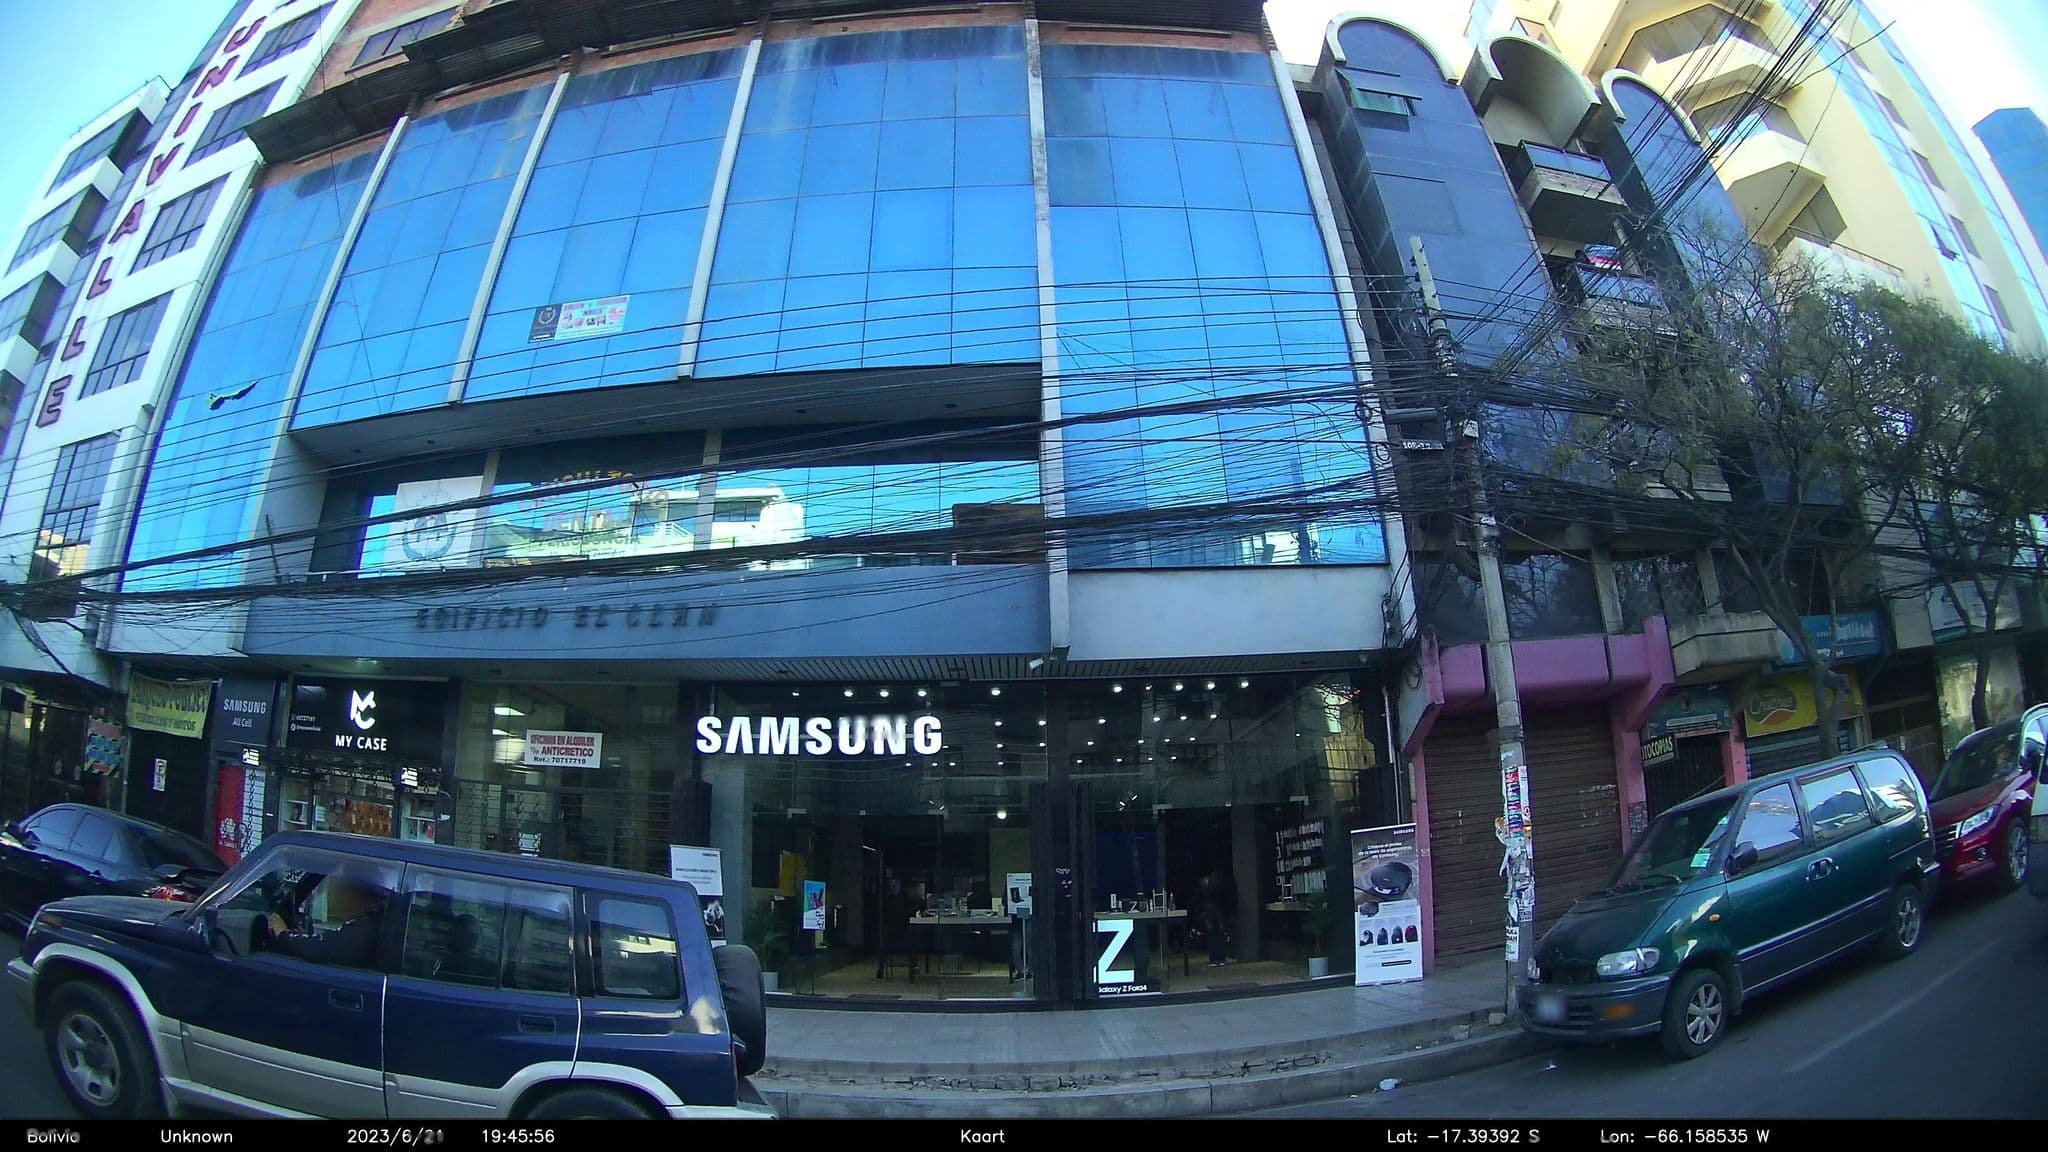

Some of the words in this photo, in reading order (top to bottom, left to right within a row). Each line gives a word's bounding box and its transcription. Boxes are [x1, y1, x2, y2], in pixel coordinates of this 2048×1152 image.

[36, 15, 268, 429] UNIVALLE
[223, 698, 267, 715] SAMSUNG
[335, 734, 353, 748] MY
[356, 736, 387, 751] CASE
[696, 716, 943, 756] SAMSUNG
[541, 746, 594, 757] ANTICRETICO
[1097, 919, 1135, 984] Z
